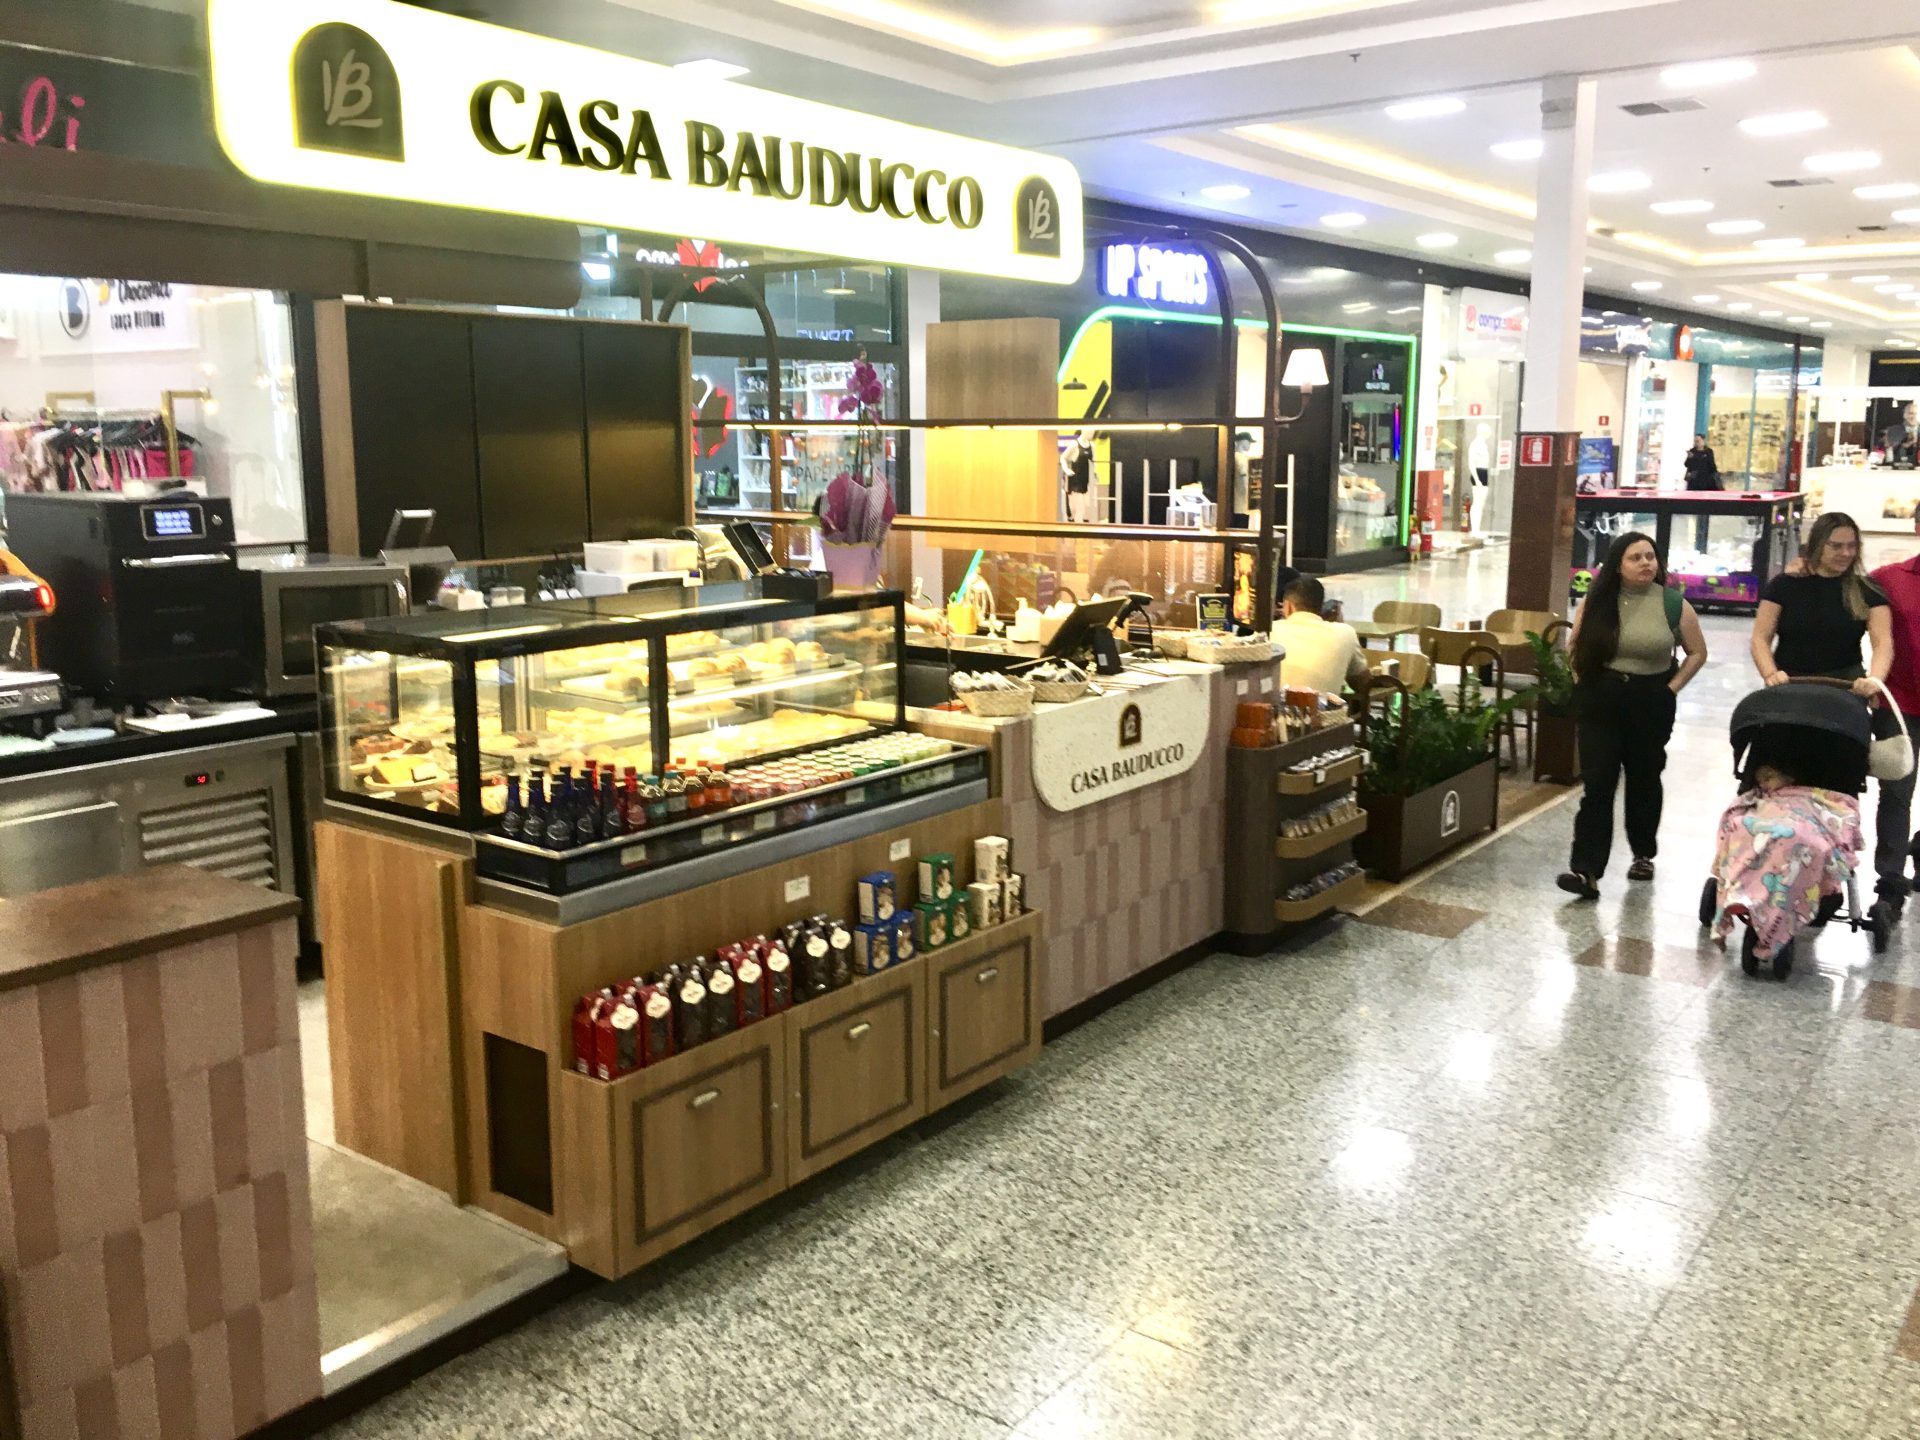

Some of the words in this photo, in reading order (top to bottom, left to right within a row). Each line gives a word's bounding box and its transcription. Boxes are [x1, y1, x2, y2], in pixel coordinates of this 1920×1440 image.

[470, 79, 672, 180] CASA
[684, 119, 984, 229] BAUDUCCO
[1070, 766, 1109, 794] CASA
[1111, 742, 1184, 782] BAUDUCCO
